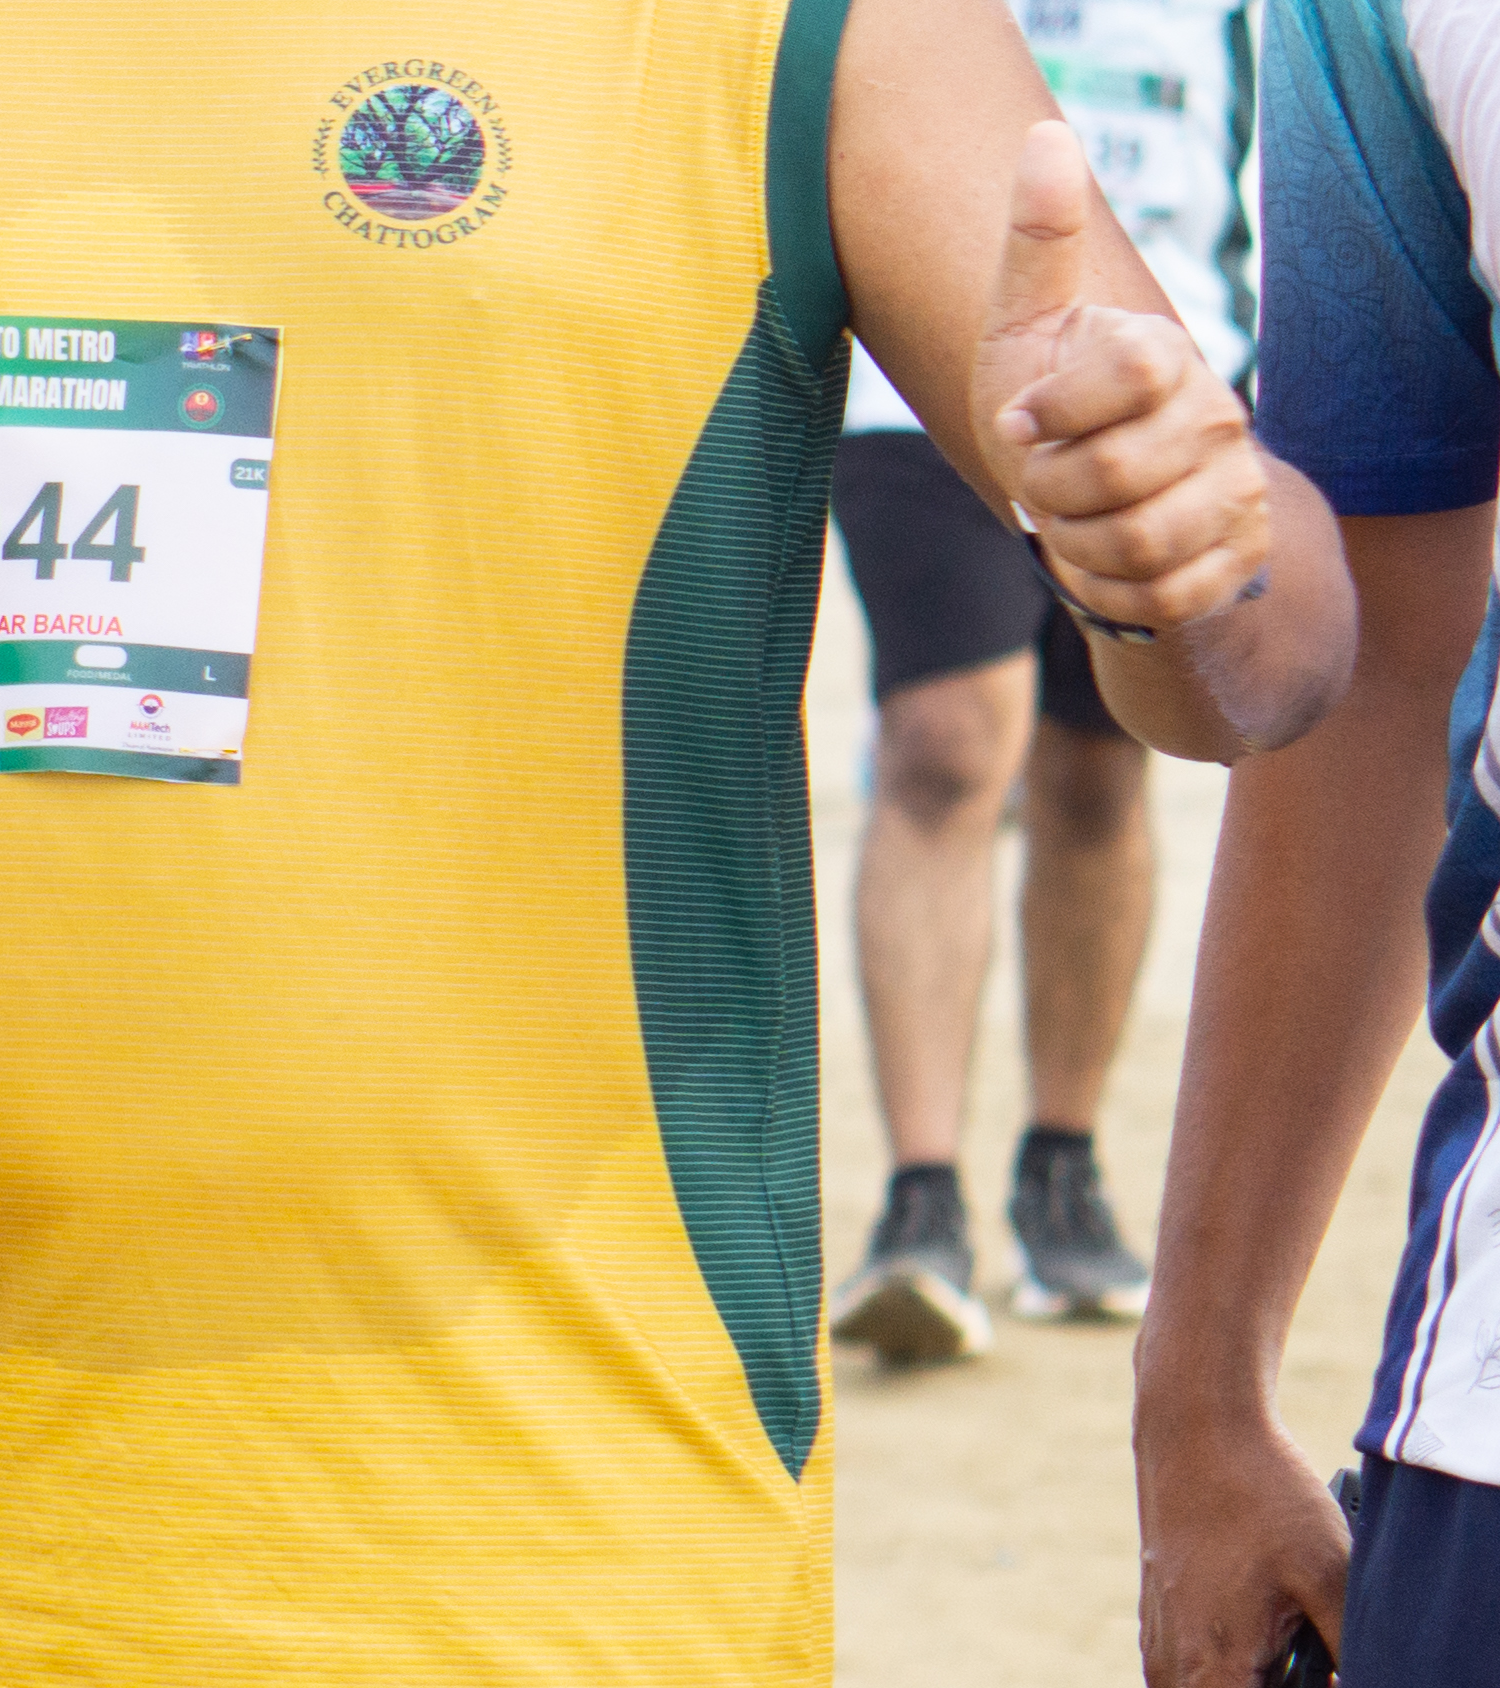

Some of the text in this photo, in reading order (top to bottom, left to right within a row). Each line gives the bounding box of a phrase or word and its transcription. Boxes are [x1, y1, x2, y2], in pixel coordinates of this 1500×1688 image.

[329, 58, 500, 116] EVERGREEN
[323, 181, 509, 250] CHATTOGRAM
[26, 326, 116, 363] METRO
[234, 466, 266, 481] 21K
[32, 614, 124, 637] BARUA
[204, 665, 217, 681] L
